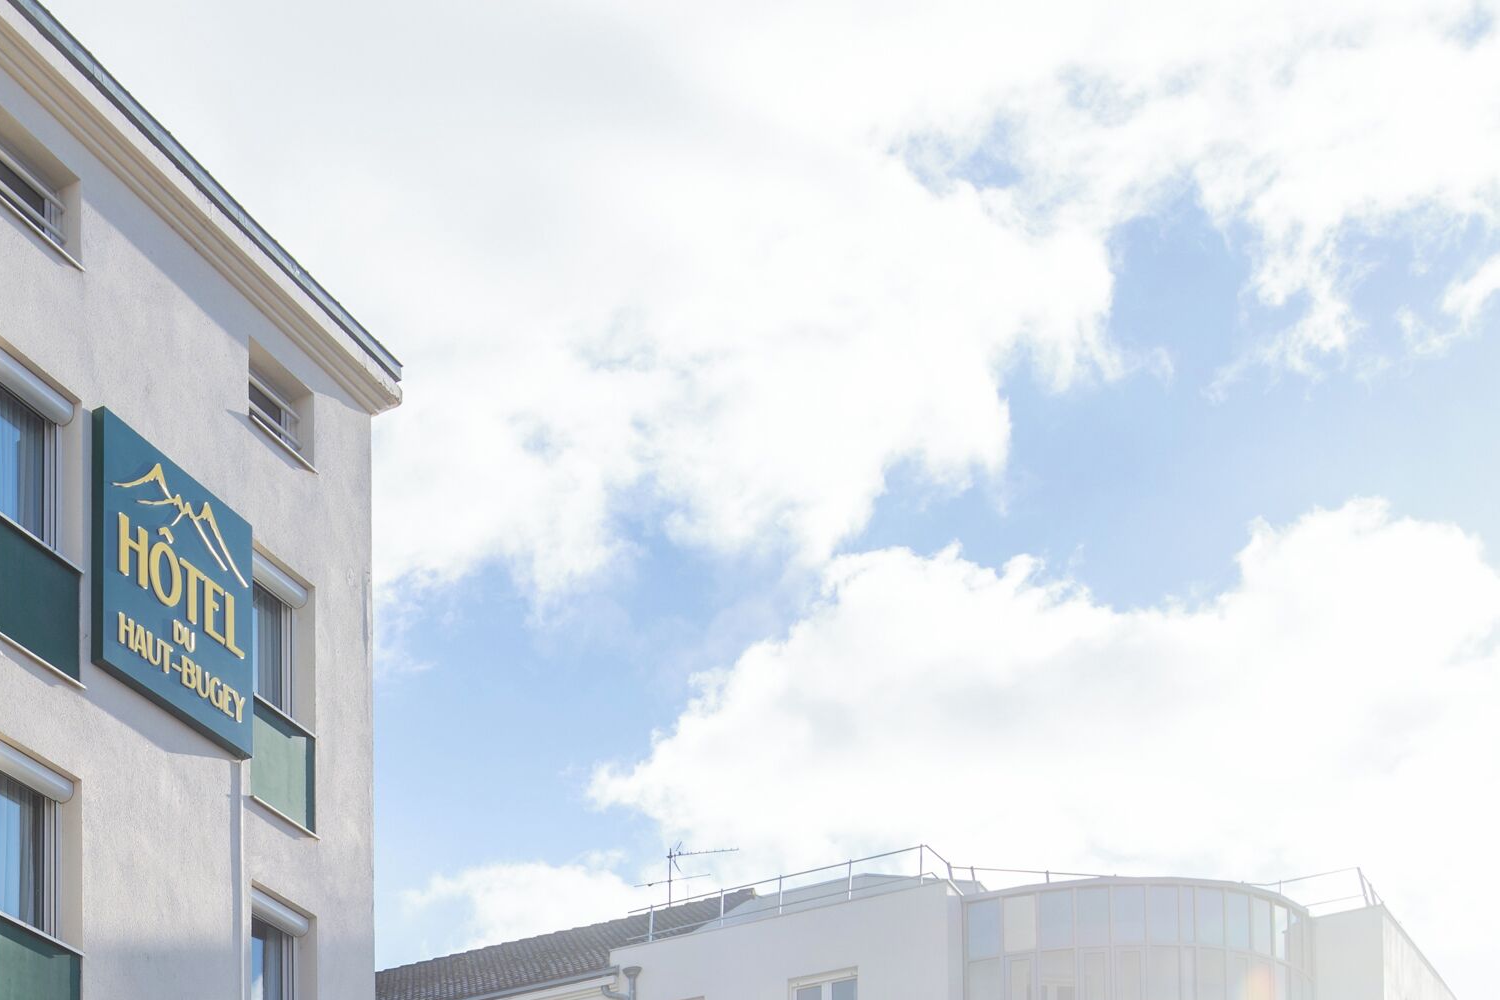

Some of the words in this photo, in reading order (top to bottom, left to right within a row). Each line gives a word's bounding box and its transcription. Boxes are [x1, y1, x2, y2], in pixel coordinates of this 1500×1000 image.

[117, 511, 245, 660] HÔTEL
[172, 619, 196, 653] DU
[117, 611, 246, 724] HAUT-BUGEY
